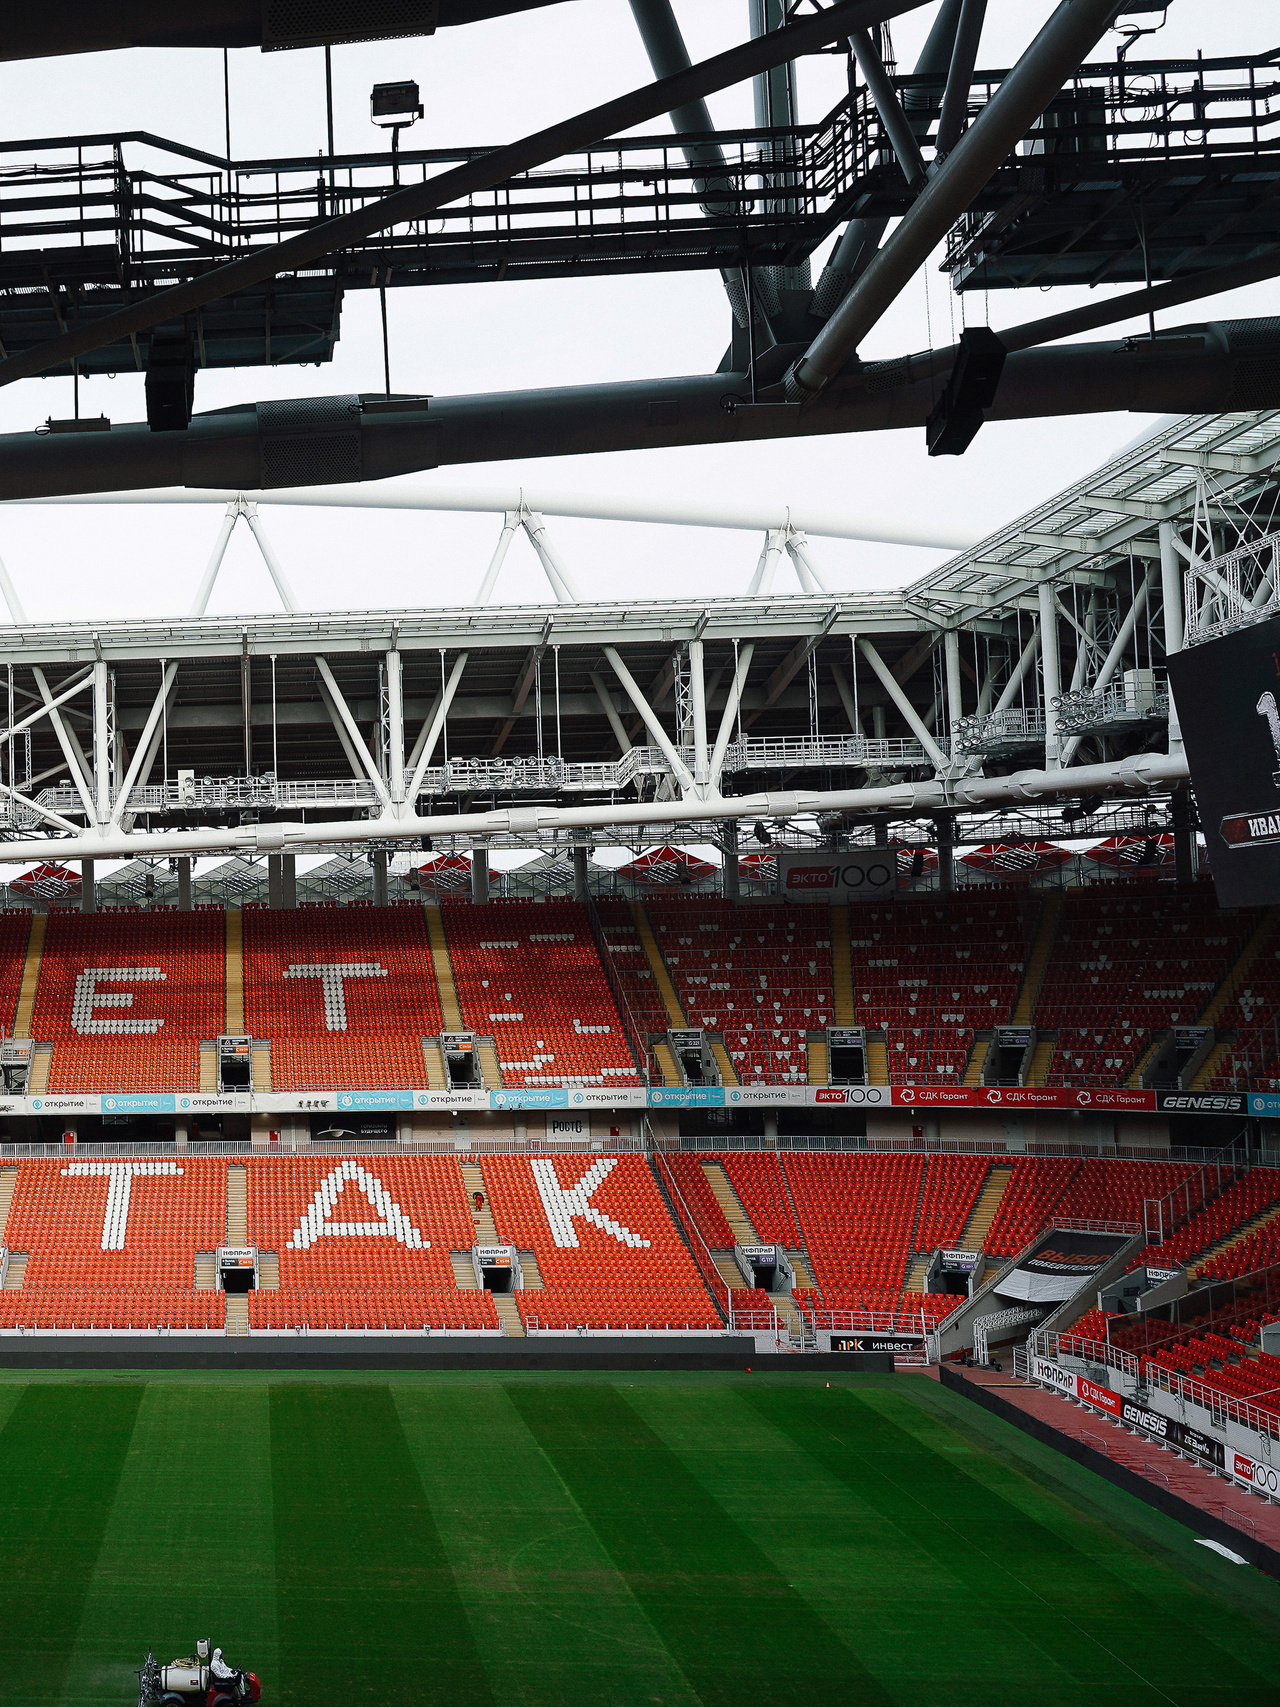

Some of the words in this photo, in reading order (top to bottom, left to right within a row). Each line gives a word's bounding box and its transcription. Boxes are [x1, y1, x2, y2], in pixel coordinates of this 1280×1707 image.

[430, 1095, 472, 1104] открытие
[586, 1094, 628, 1102] открытие
[743, 1091, 786, 1100] открытие
[919, 1092, 939, 1100] СДК
[940, 1092, 968, 1101] Гарант
[1006, 1092, 1026, 1101] СДК
[1027, 1093, 1057, 1102] Гарант
[1095, 1094, 1115, 1103] СДК
[44, 1100, 84, 1108] открытие
[192, 1099, 233, 1107] открытие
[1162, 1097, 1242, 1110] GENESIS
[1123, 1404, 1168, 1436] GENESIS
